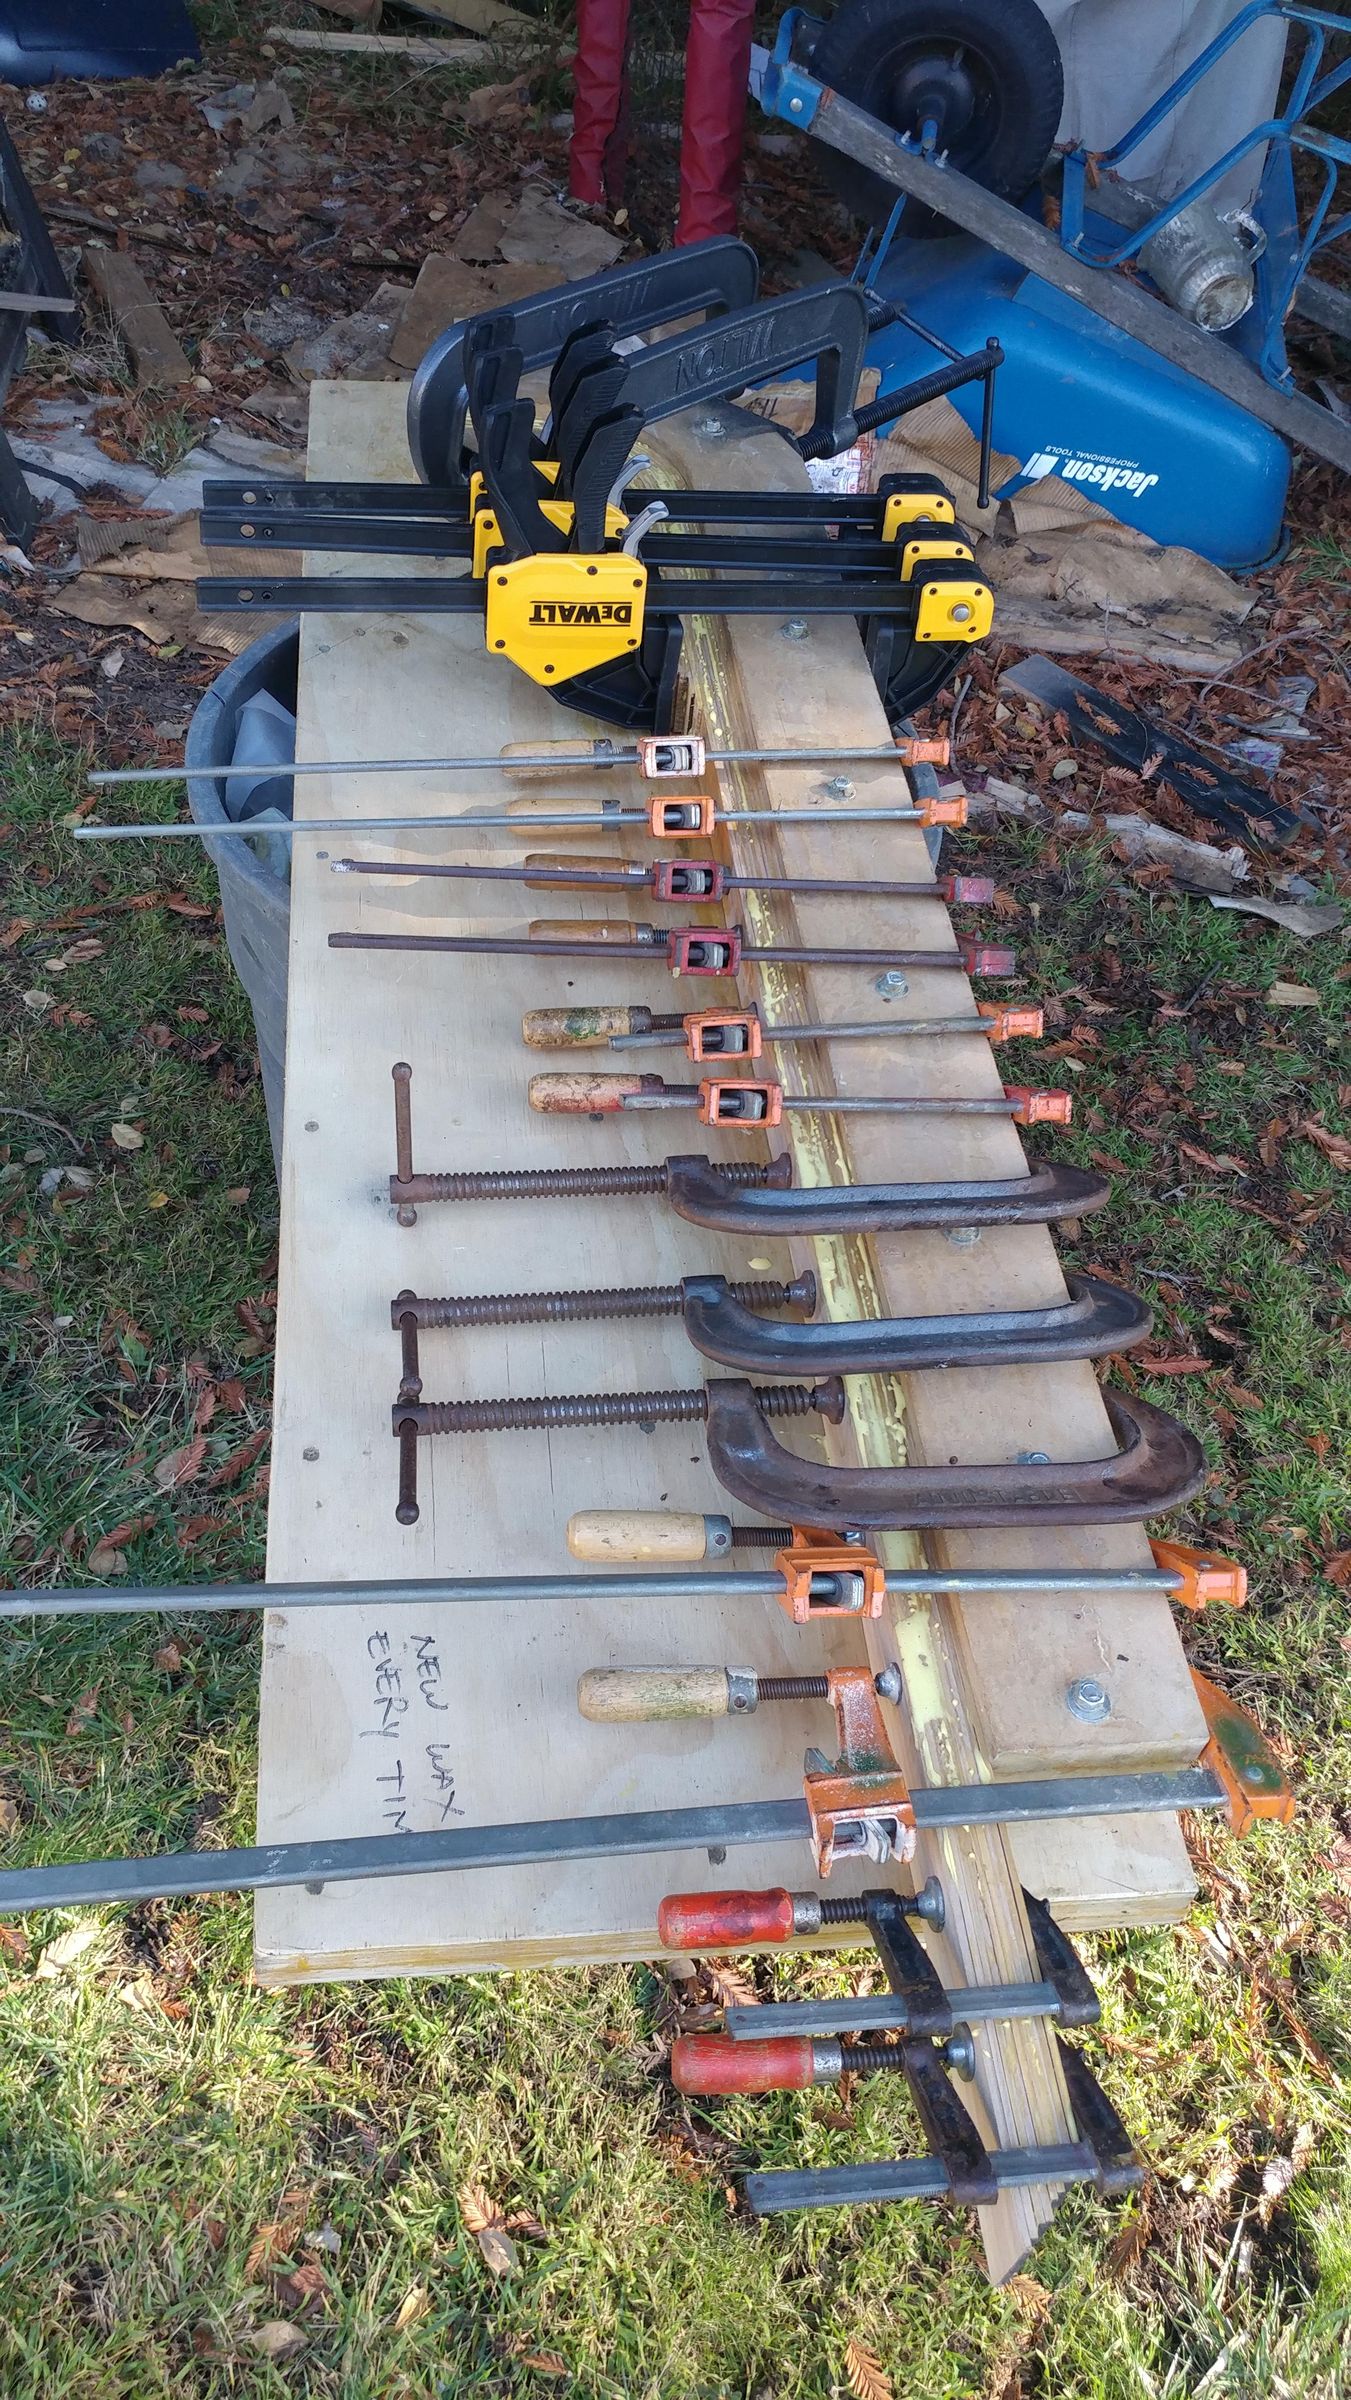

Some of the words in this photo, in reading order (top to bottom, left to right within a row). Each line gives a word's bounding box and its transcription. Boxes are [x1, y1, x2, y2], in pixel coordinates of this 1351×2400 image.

[674, 317, 776, 392] WILTON
[1044, 445, 1073, 457] TOOLS
[1061, 458, 1159, 497] Jackson
[1076, 452, 1140, 469] PROFESSIONAL
[358, 1630, 409, 1739] EVERY
[410, 1635, 449, 1710] NEW
[423, 1743, 466, 1822] WAX
